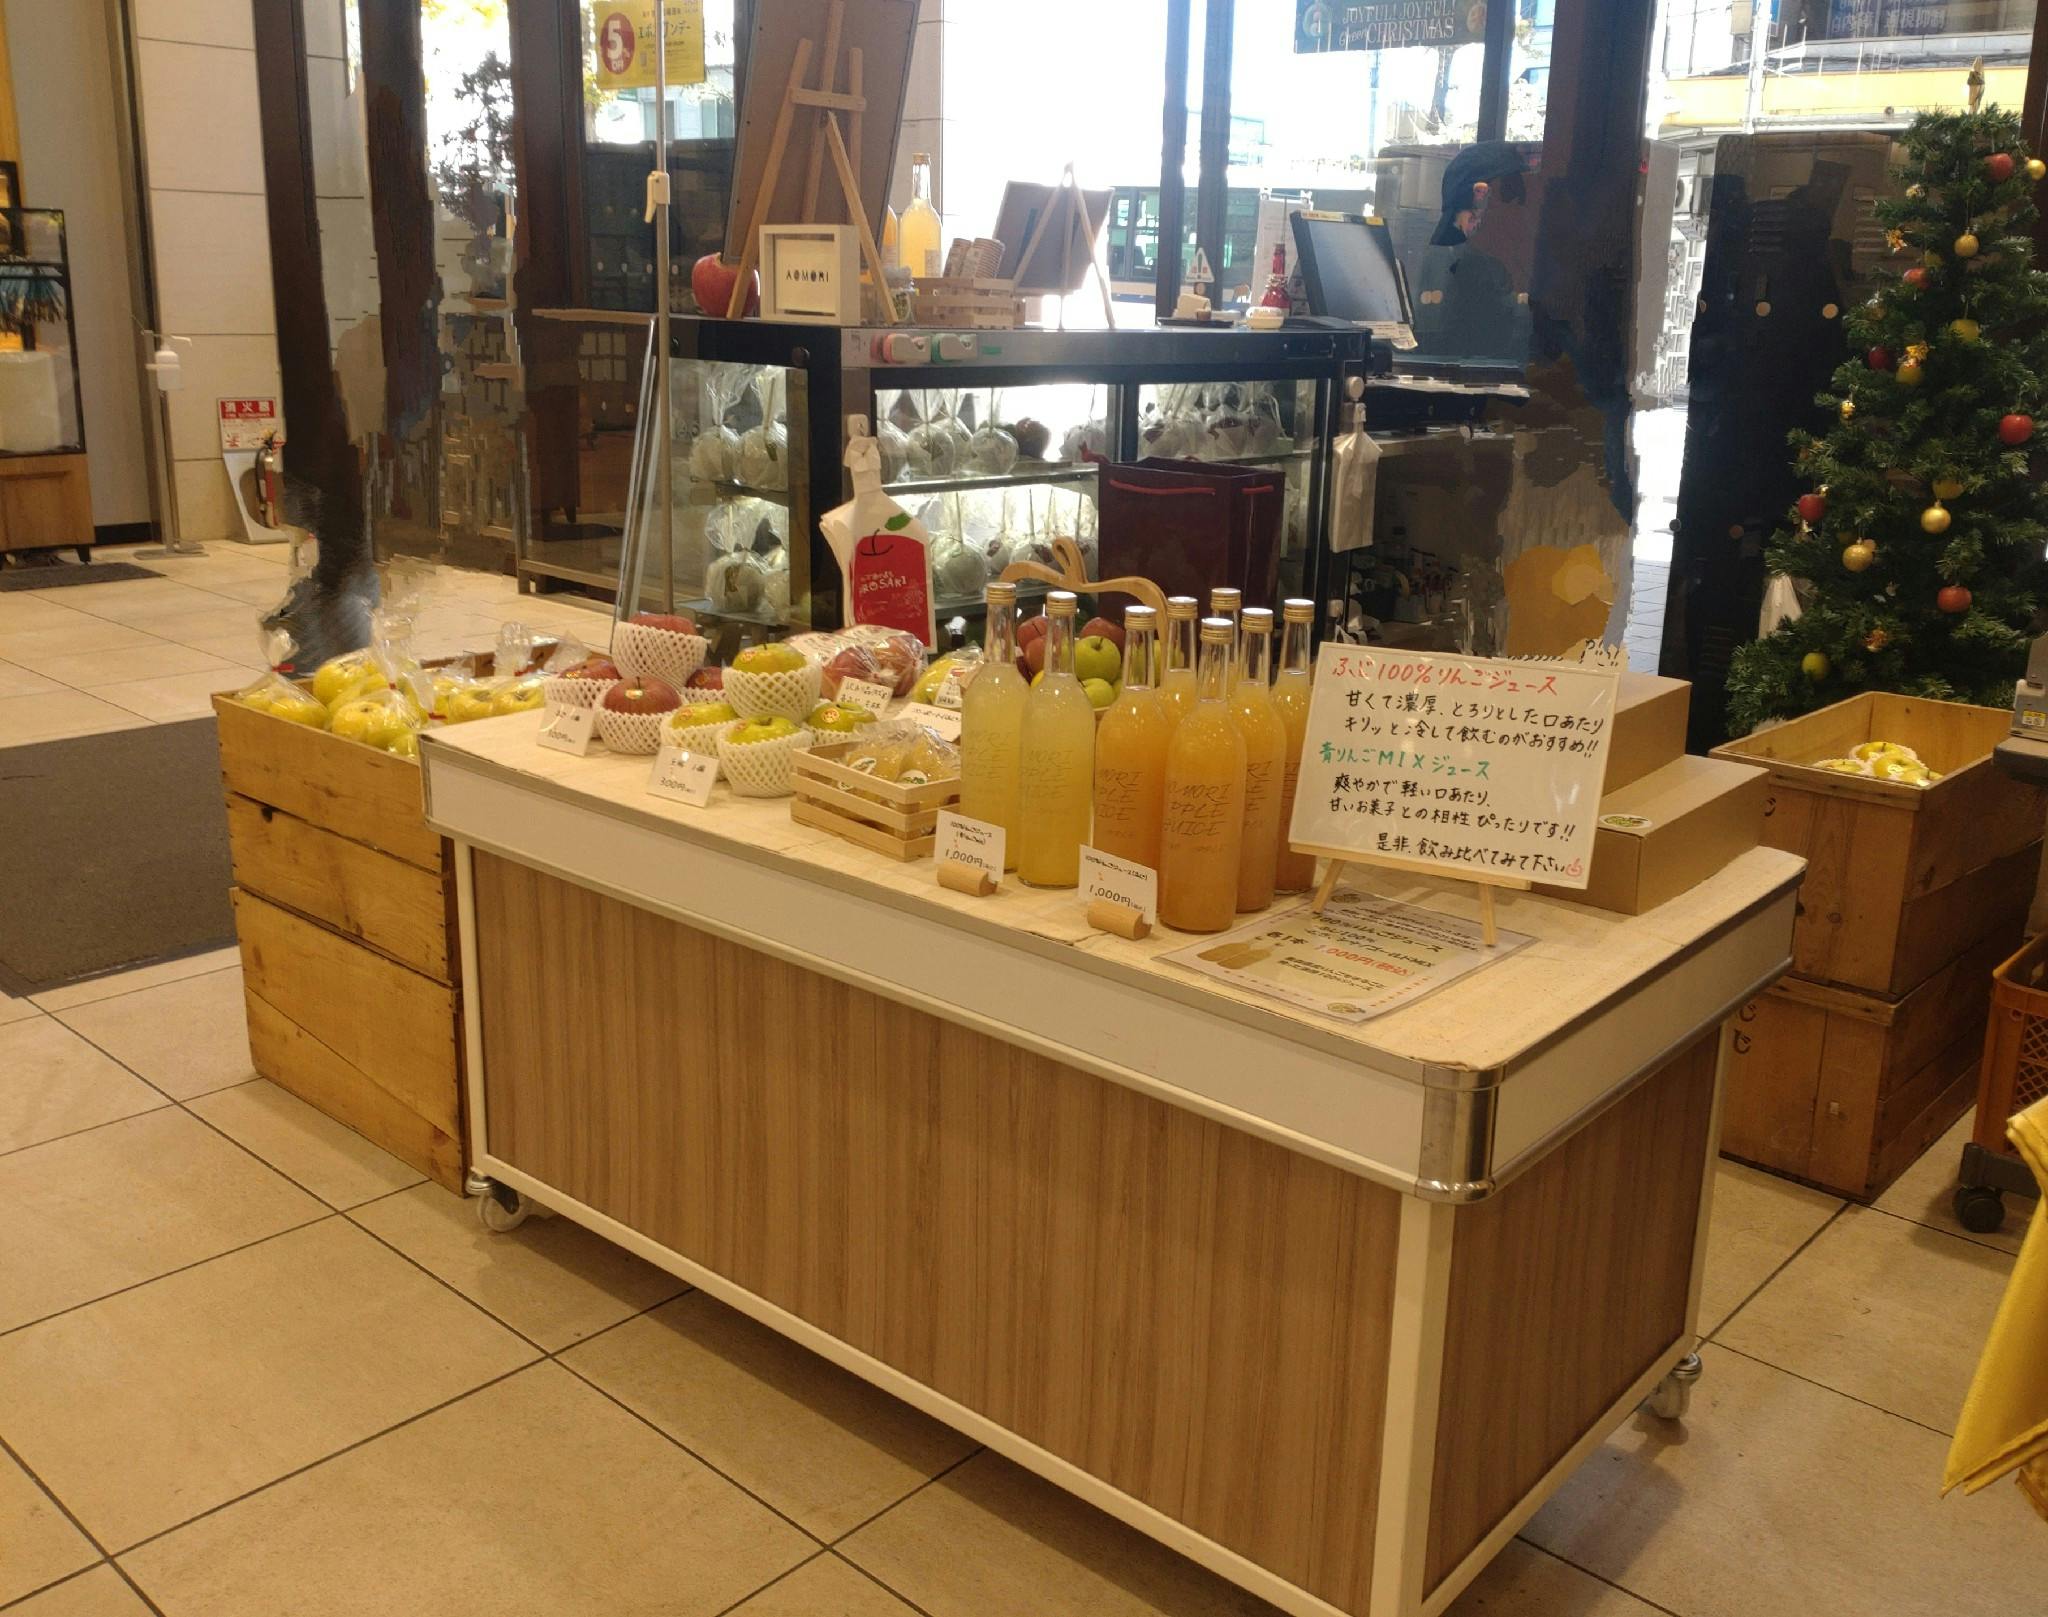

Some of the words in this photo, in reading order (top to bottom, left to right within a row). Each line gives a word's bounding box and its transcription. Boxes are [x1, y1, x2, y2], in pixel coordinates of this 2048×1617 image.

[1366, 17, 1454, 43] CHRISTMAS
[785, 269, 829, 283] AOMORI
[1332, 656, 1558, 697] ふじ100%りんごジュース
[1166, 782, 1232, 803] OMORI
